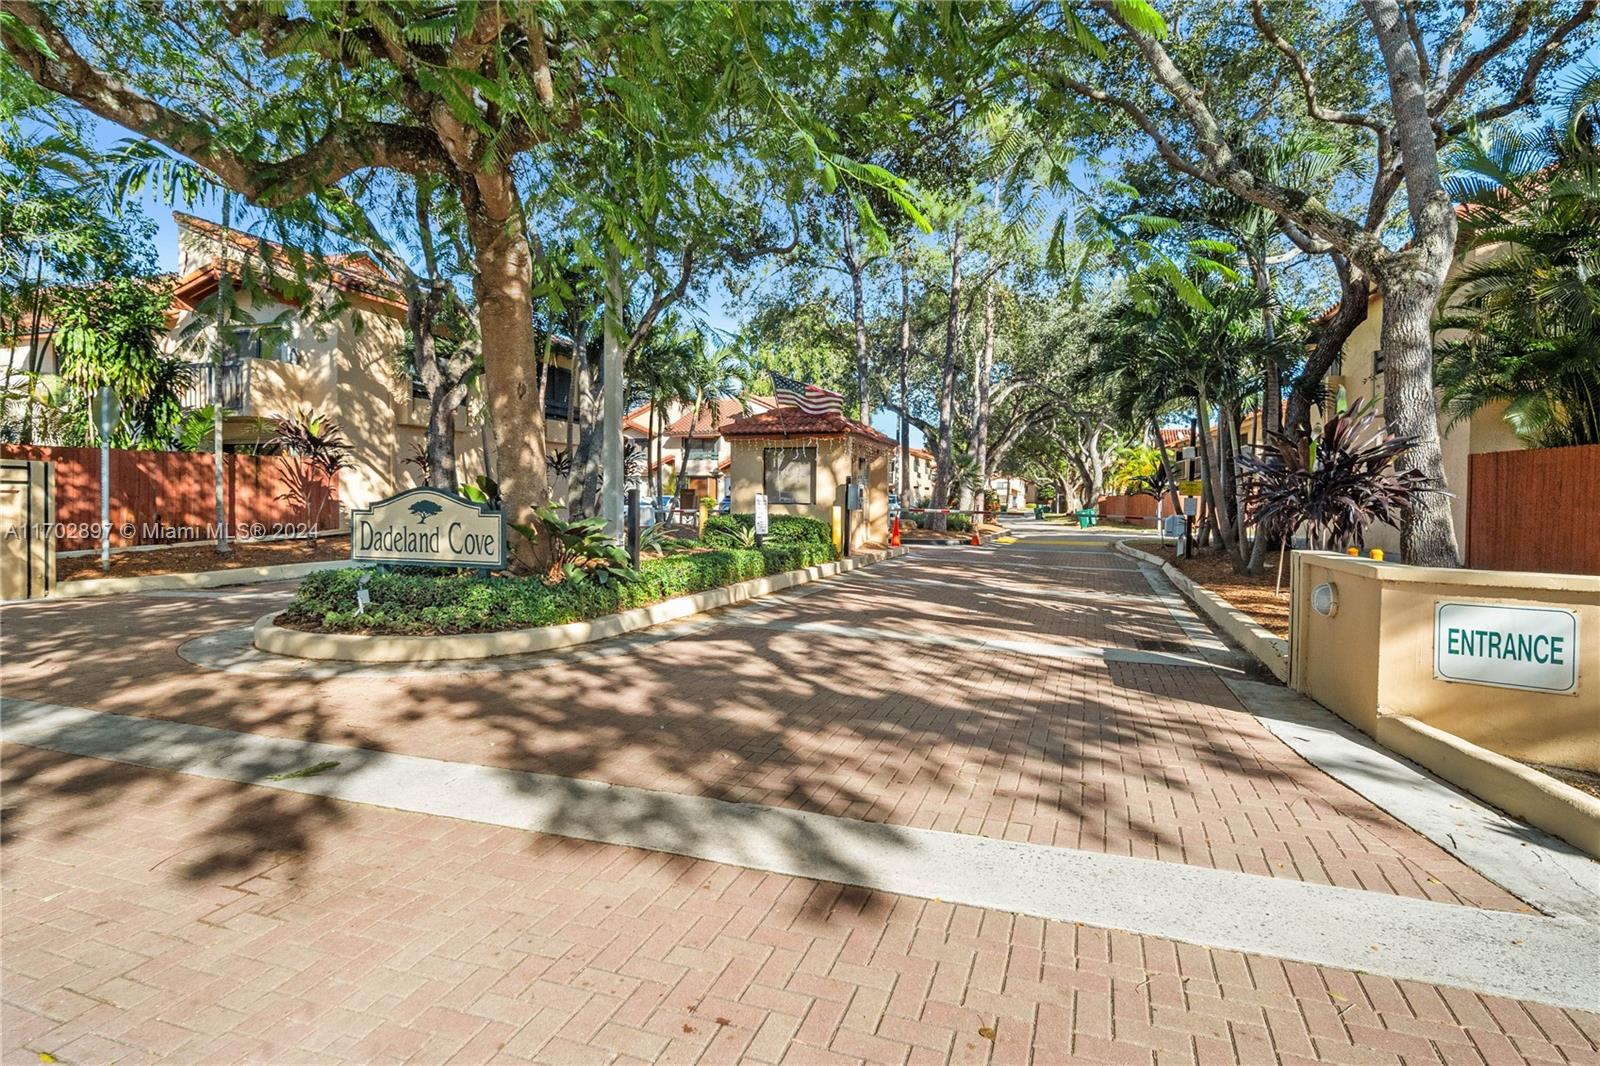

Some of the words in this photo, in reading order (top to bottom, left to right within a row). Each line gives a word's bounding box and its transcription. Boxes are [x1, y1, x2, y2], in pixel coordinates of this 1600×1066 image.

[360, 520, 440, 553] Dadeland
[448, 522, 495, 556] Cove
[1447, 627, 1564, 665] ENTRANCE
